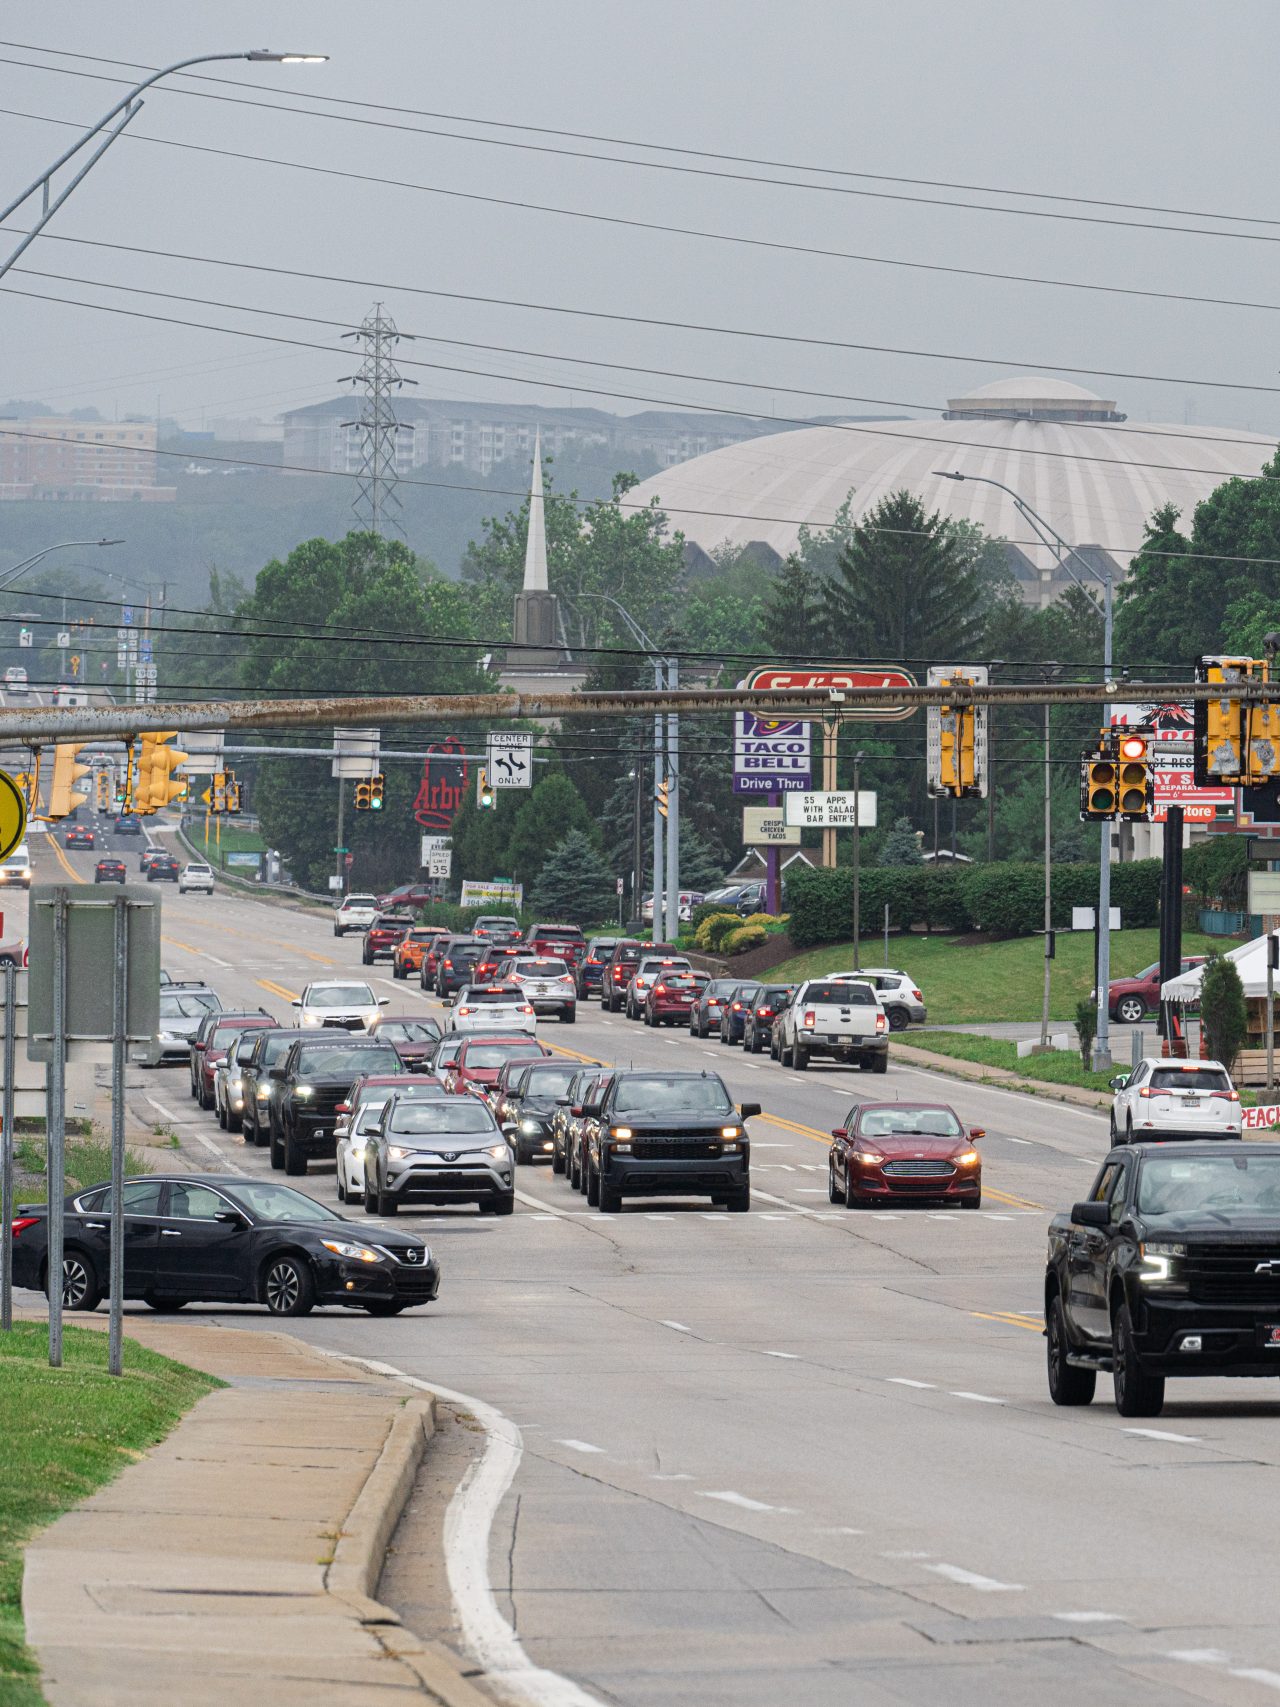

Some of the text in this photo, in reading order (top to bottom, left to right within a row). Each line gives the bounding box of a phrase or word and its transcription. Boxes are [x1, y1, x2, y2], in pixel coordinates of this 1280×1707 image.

[741, 743, 805, 753] TACO
[745, 757, 806, 768] BELL
[740, 778, 804, 788] Drive Thru
[826, 796, 847, 804] APPS
[829, 806, 855, 814] SALAD
[432, 865, 448, 875] 35
